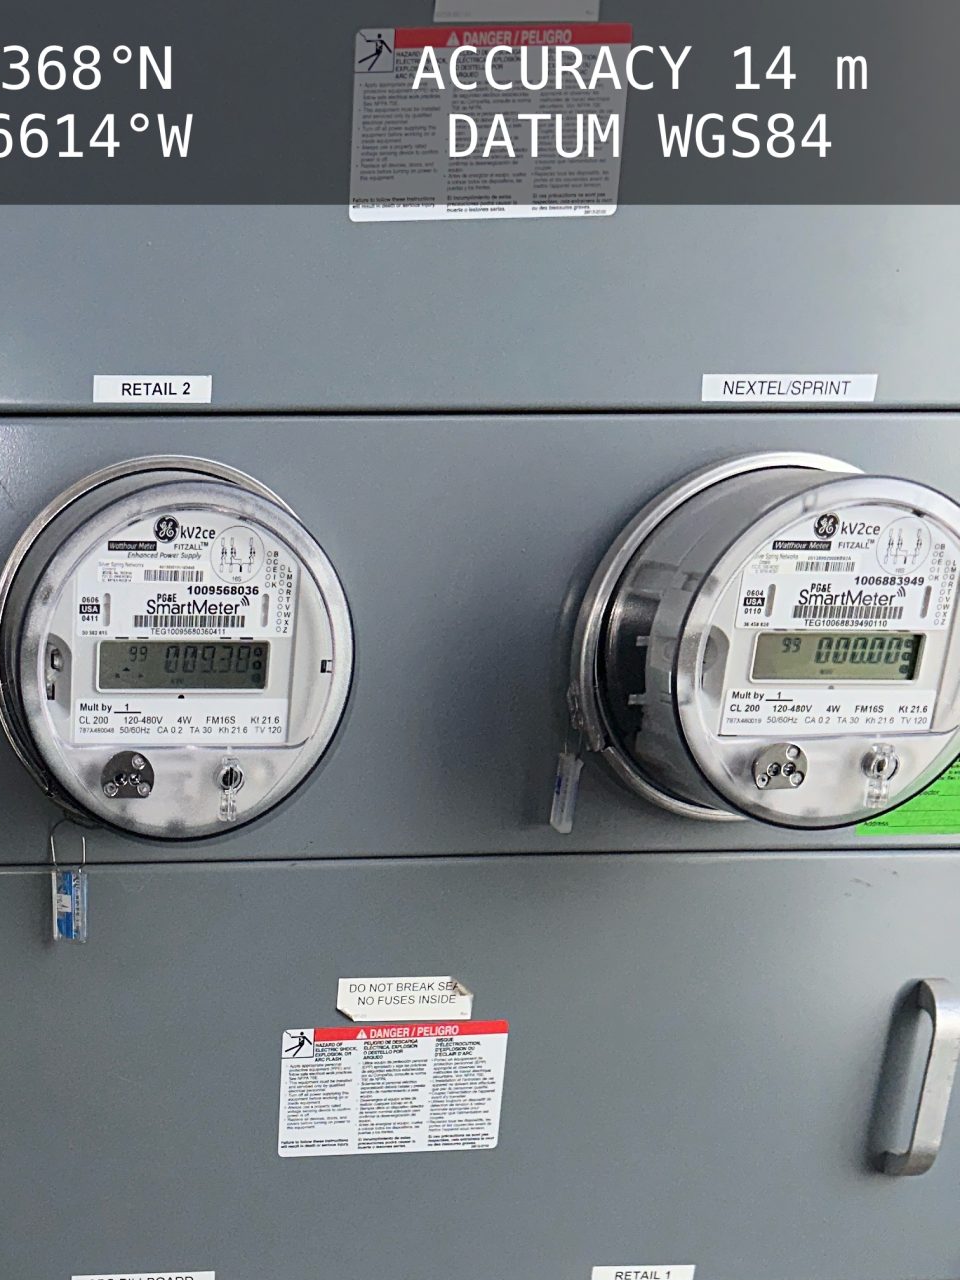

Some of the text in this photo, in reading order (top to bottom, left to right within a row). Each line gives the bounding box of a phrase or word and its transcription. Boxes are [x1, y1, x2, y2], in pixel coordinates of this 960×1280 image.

[463, 29, 572, 46] DANGER PELIGRO
[122, 382, 191, 396] RETAIL 2
[723, 380, 851, 396] NEXTEL/SPRINT
[181, 525, 215, 540] kV2ce
[841, 521, 880, 536] kV2ce
[139, 542, 156, 550] Meter
[775, 541, 830, 550] Watthour Meter
[180, 552, 202, 560] Supply
[854, 576, 925, 586] 1006883949
[187, 585, 259, 595] 1009568036
[811, 583, 832, 593] PG&E
[157, 593, 177, 603] PG&E
[798, 589, 896, 606] SmartMeter
[81, 605, 98, 613] USA
[146, 599, 240, 615] SmartMeter
[732, 691, 781, 701] Mult by 1
[80, 703, 129, 713] Mult by 1
[730, 704, 742, 712] CL
[745, 704, 760, 712] 200
[773, 704, 813, 712] 120-480V
[826, 705, 840, 713] 4W
[855, 705, 884, 713] FM16S
[910, 705, 928, 713] 21.6
[79, 716, 91, 724] CL
[93, 716, 109, 724] 200
[124, 716, 163, 724] 120-480V
[177, 716, 192, 724] 4W
[206, 716, 236, 724] FM16S
[261, 716, 280, 724] 21.6
[767, 716, 798, 724] 50/60Hz
[805, 716, 816, 724] CA
[914, 716, 927, 724] 120
[119, 726, 151, 734] 50/60Hz
[267, 726, 282, 734] 120
[349, 981, 458, 993] DO NOT BREAK SEA
[357, 994, 456, 1006] NO FUSES INSIDE
[369, 1025, 459, 1039] DANGER PELIGRO
[614, 1270, 671, 1280] RETAIL 1
